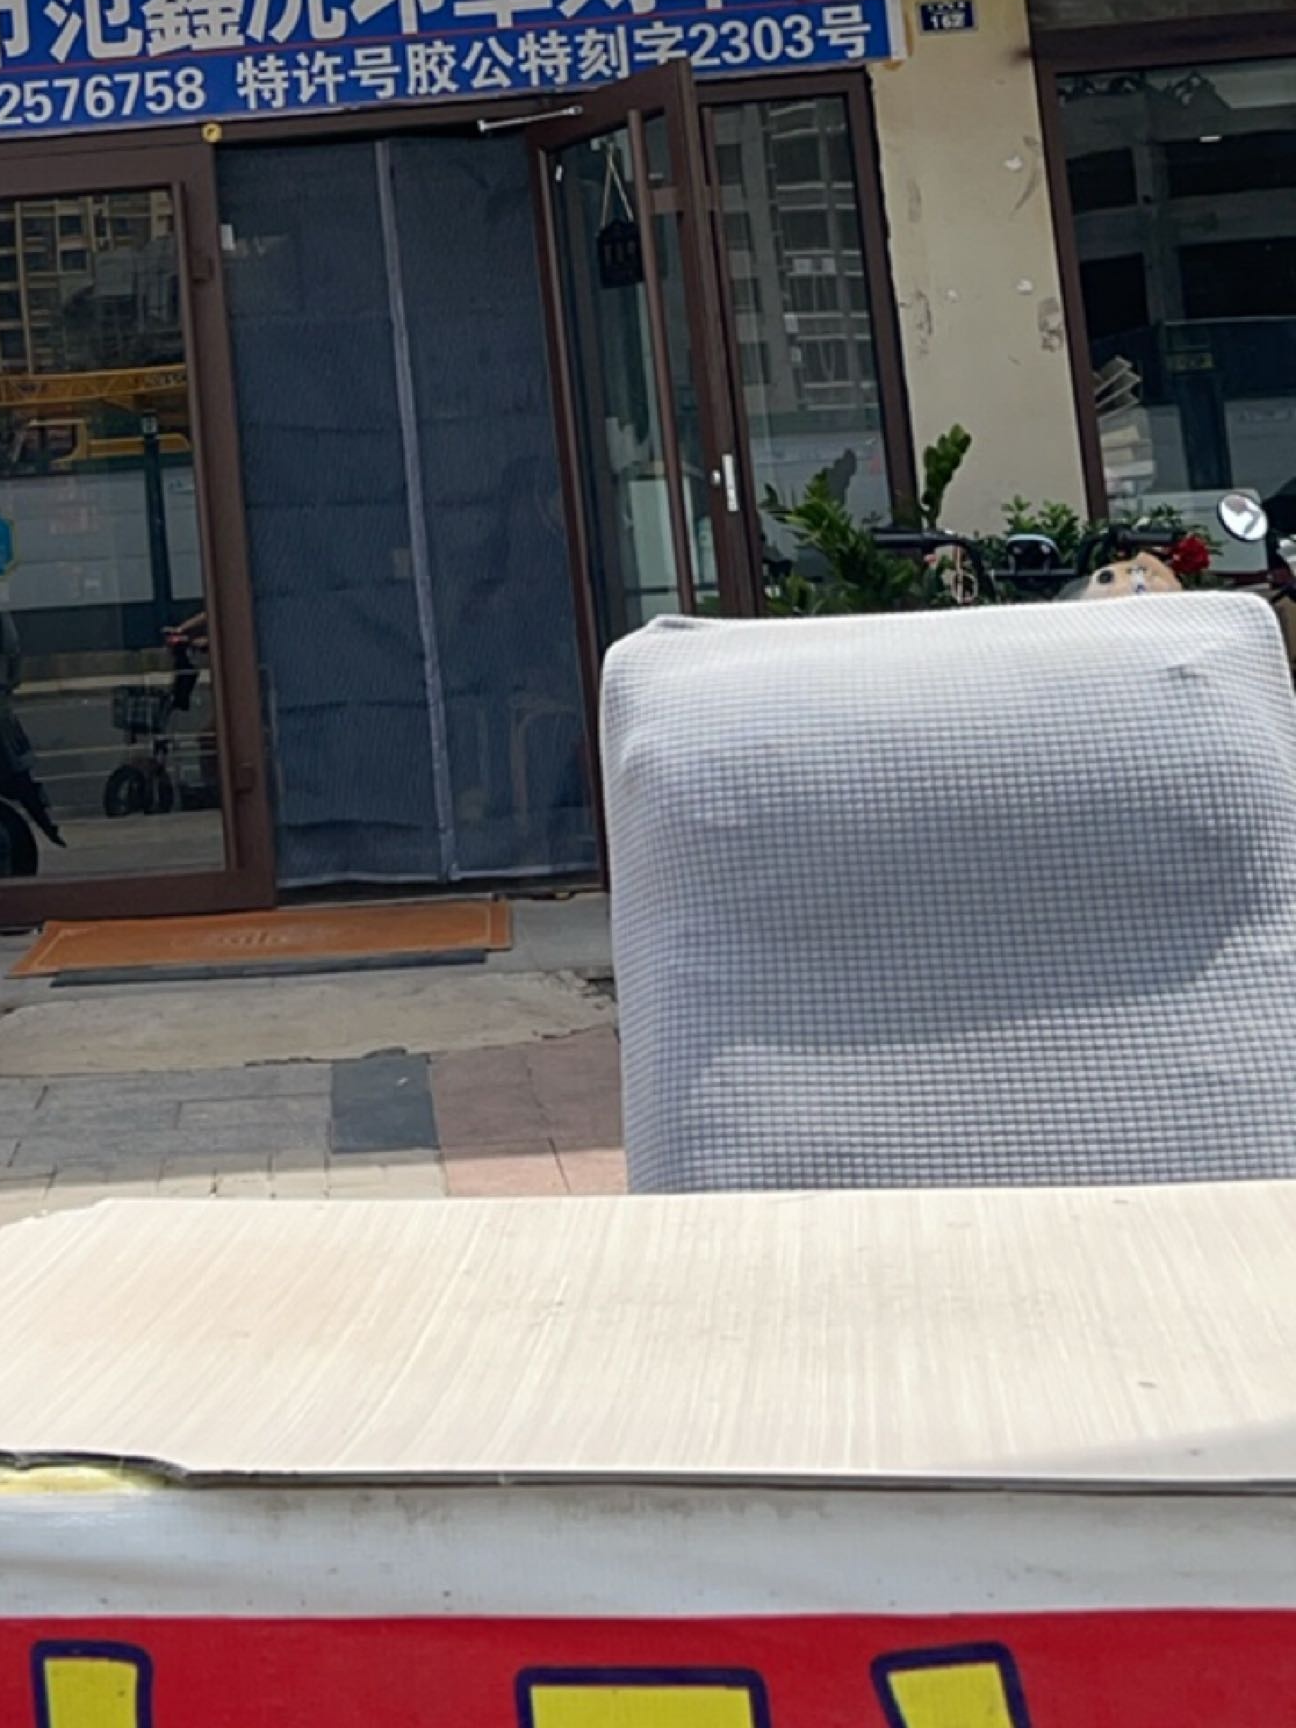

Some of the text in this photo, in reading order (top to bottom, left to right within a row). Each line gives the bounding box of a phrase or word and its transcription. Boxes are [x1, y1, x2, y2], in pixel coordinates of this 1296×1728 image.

[235, 9, 872, 110] 特许号胶公特刻字2303号
